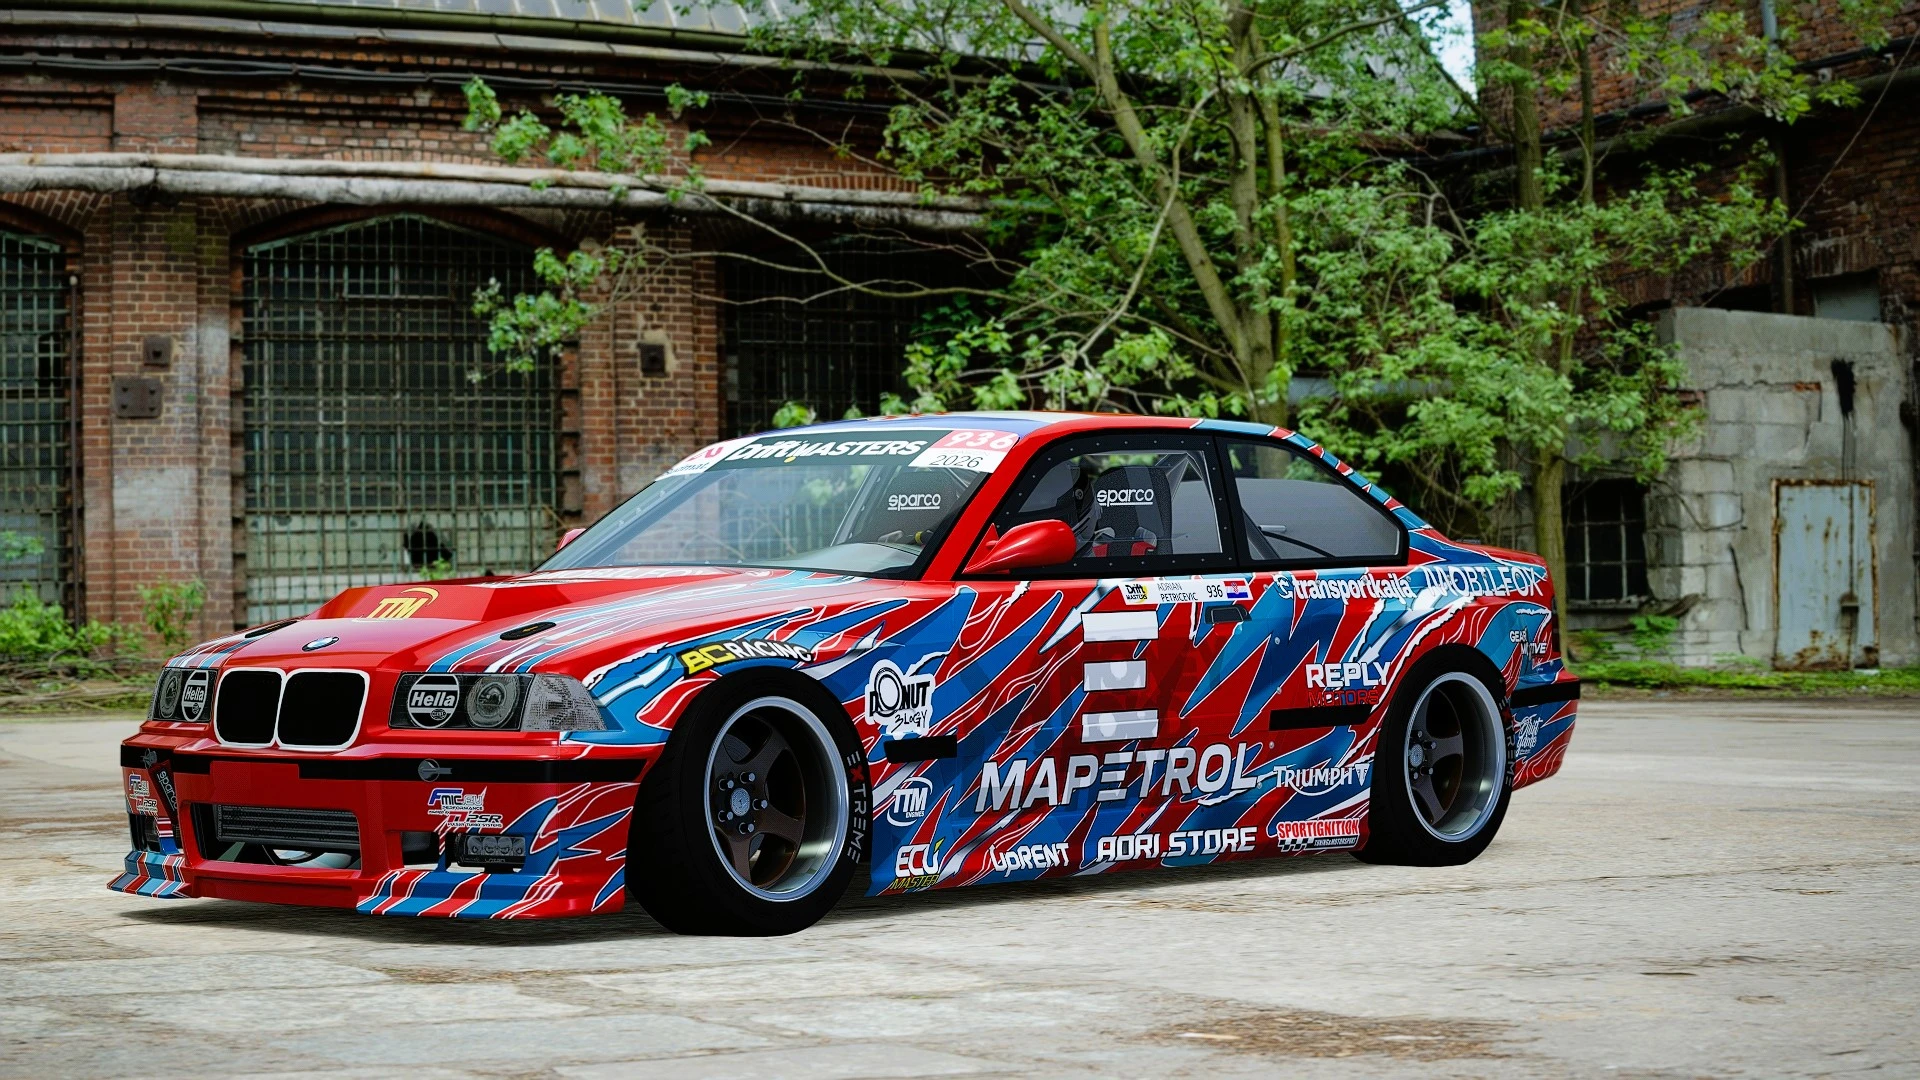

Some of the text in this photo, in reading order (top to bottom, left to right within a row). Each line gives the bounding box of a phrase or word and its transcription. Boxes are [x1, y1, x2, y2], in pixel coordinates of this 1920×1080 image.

[944, 432, 1014, 450] 936
[929, 455, 984, 468] 2026
[888, 493, 941, 511] sparco
[1097, 488, 1154, 507] sparco
[1157, 583, 1183, 592] ADRIAN
[1207, 585, 1223, 598] 936
[1305, 661, 1391, 689] REPLY
[184, 686, 205, 702] Hella
[410, 691, 456, 707] Hella
[1308, 689, 1379, 707] MOTORS
[974, 743, 1258, 813] MAPETROL
[1273, 765, 1352, 792] TRIUMPH
[846, 751, 867, 864] EXTREME
[893, 787, 929, 814] TTM
[905, 810, 925, 819] ENGINES
[1277, 819, 1359, 839] SPORTIGNITION
[895, 842, 941, 878] ECU
[890, 875, 941, 890] MASTER
